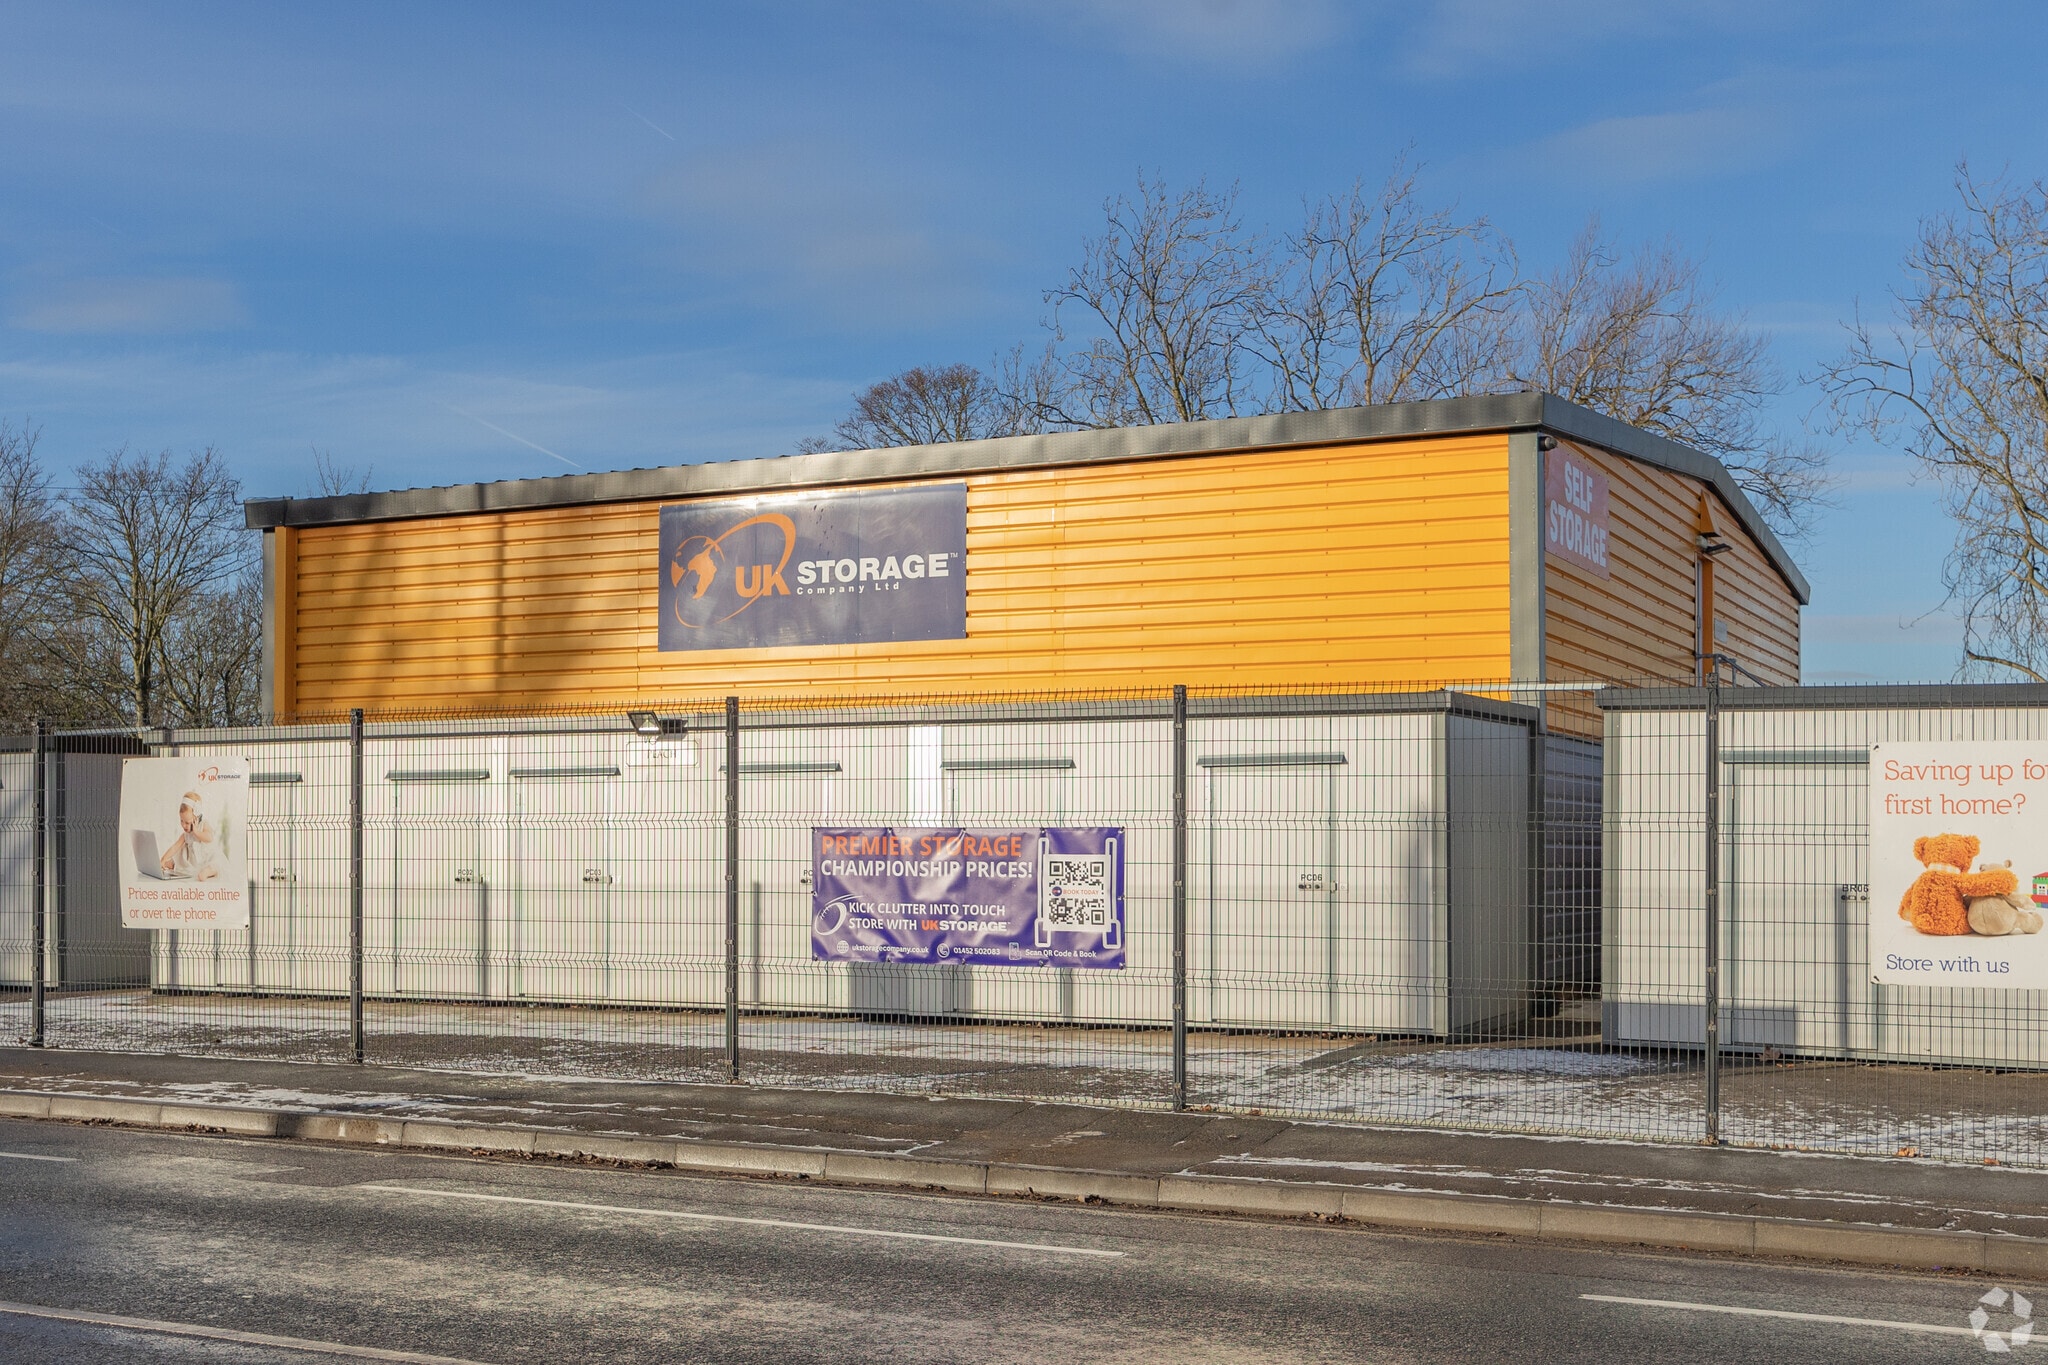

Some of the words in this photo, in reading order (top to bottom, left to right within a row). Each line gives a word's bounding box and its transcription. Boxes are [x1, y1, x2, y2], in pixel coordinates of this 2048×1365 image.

[1564, 461, 1593, 514] SELF
[1550, 499, 1607, 568] STORAGE
[735, 564, 791, 598] UK
[796, 583, 865, 595] Company
[875, 581, 900, 591] Ltd
[1884, 759, 1972, 787] Saving
[1978, 765, 2014, 786] up
[1884, 793, 1932, 815] first
[1940, 793, 2026, 815] home?
[821, 835, 913, 856] PREMIER
[919, 836, 1022, 857] STORAGE
[821, 859, 962, 878] CHAMPIONSHIP
[966, 861, 1033, 878] PRICES!
[1300, 873, 1323, 881] PC06
[128, 887, 159, 901] Prices
[161, 887, 205, 901] available
[207, 888, 240, 901] online
[129, 908, 139, 919] or
[142, 909, 164, 919] over
[166, 907, 182, 920] the
[184, 908, 217, 922] phone
[848, 902, 874, 914] KICK
[877, 902, 927, 915] CLUTTER
[929, 903, 959, 916] INTO
[962, 904, 1006, 917] TOUCH
[848, 918, 884, 930] STORE
[887, 919, 918, 931] WITH
[851, 944, 929, 954] ukstoragecompany.co.uk
[953, 947, 974, 955] 01452
[974, 947, 1001, 955] 502083
[1025, 949, 1043, 957] Scan
[1043, 950, 1053, 958] QR
[1886, 954, 1933, 971] Store
[1938, 956, 1981, 973] with
[1987, 961, 2010, 973] us
